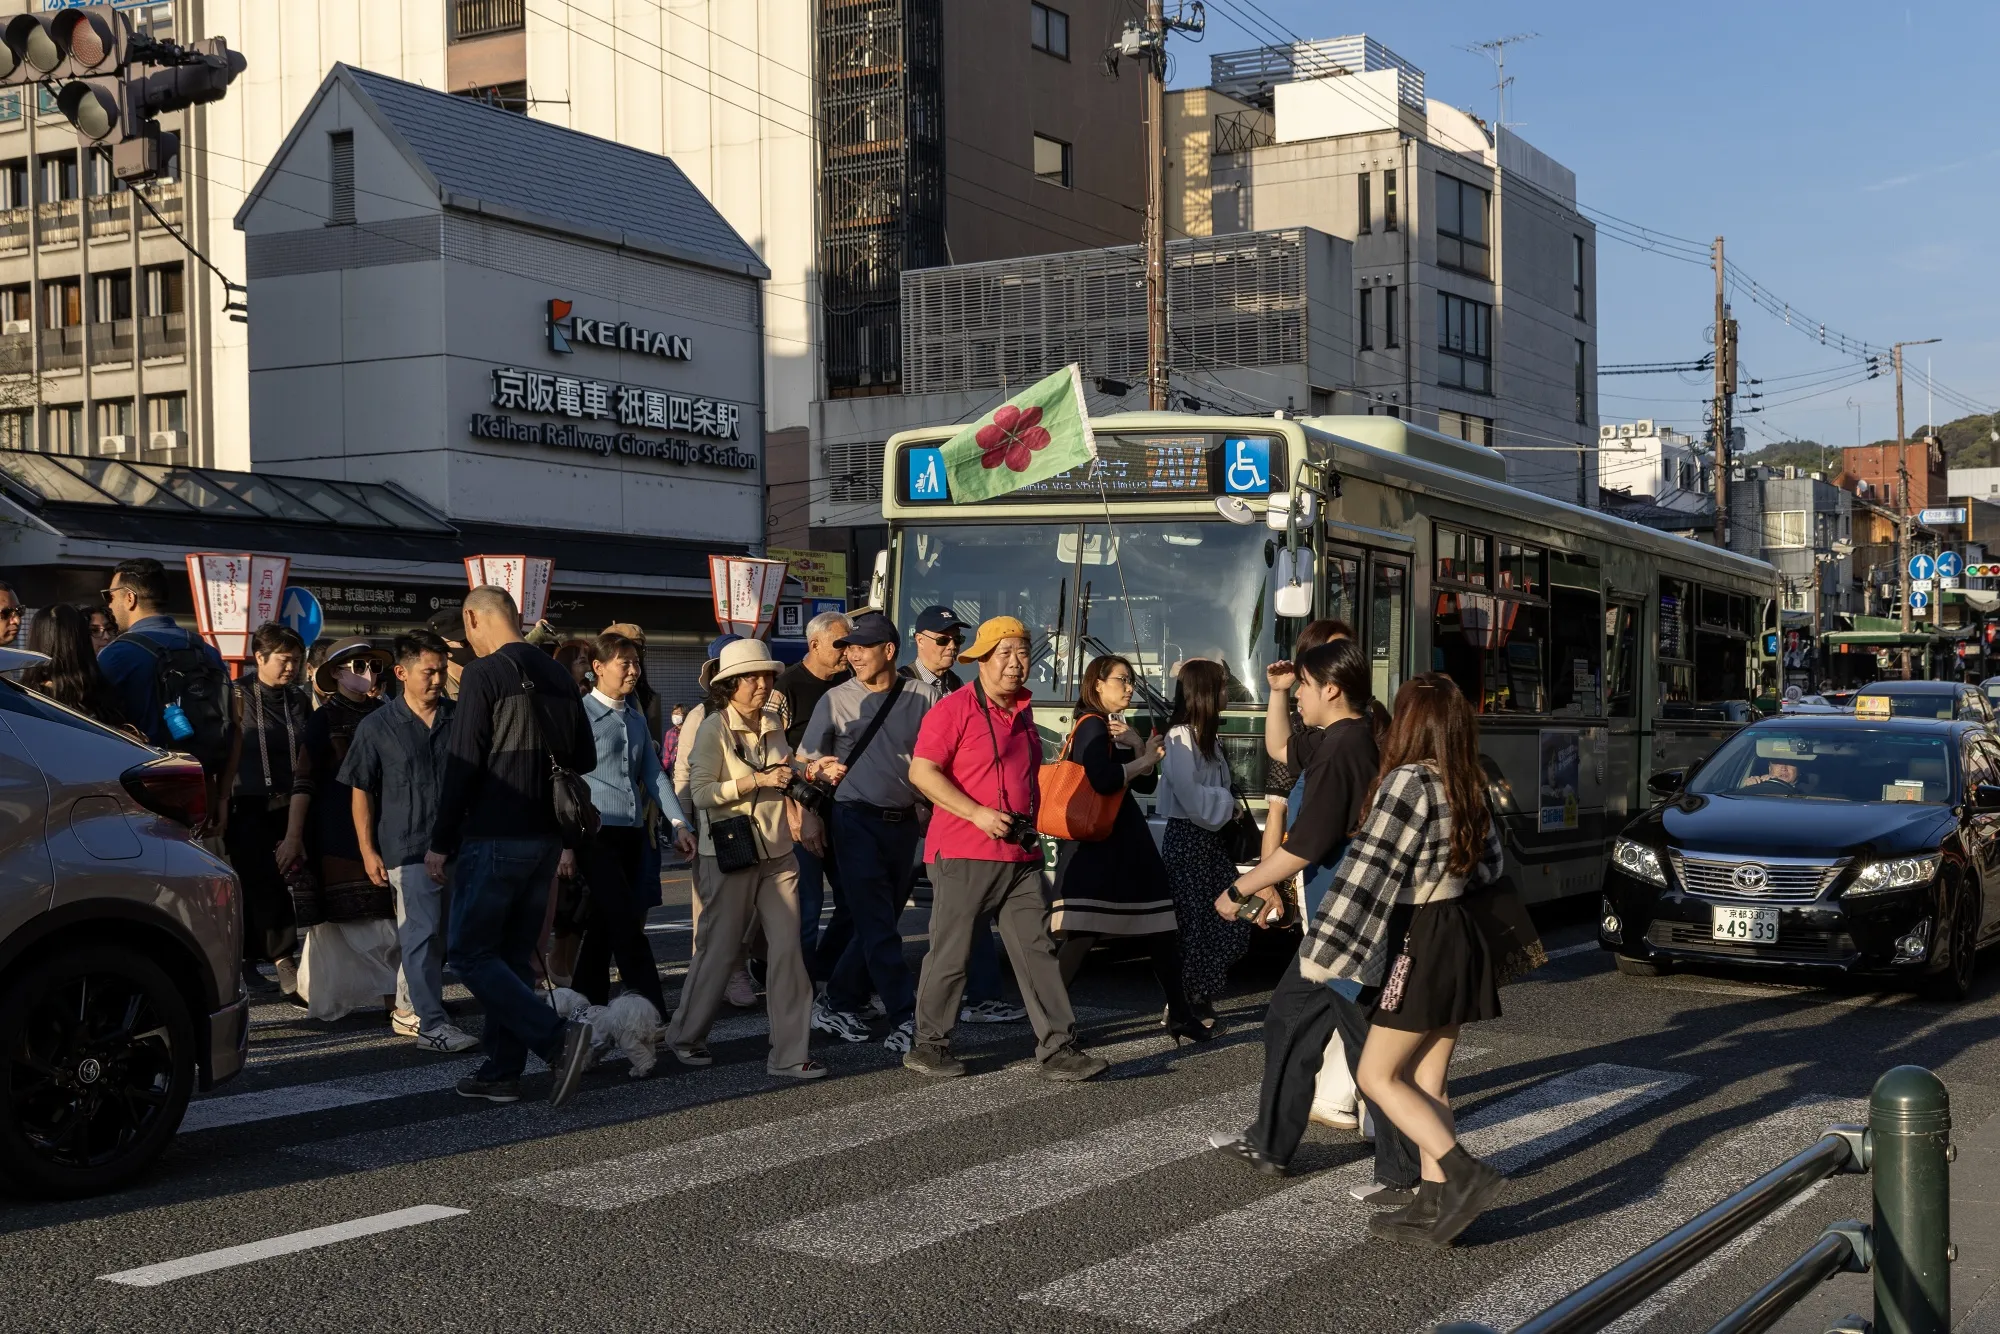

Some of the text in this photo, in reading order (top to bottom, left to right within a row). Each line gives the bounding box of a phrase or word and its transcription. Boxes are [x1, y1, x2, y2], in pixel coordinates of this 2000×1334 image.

[574, 317, 692, 361] KEIHAN
[496, 368, 740, 441] 京阪電車 祇園四条駅
[475, 415, 757, 469] Keihan Railway Gion-shijo Station
[258, 569, 274, 619] 月桂冠
[326, 603, 351, 613] Railway
[388, 606, 411, 614] Station
[547, 600, 585, 611] レベーター
[1727, 920, 1775, 940] 49-39
